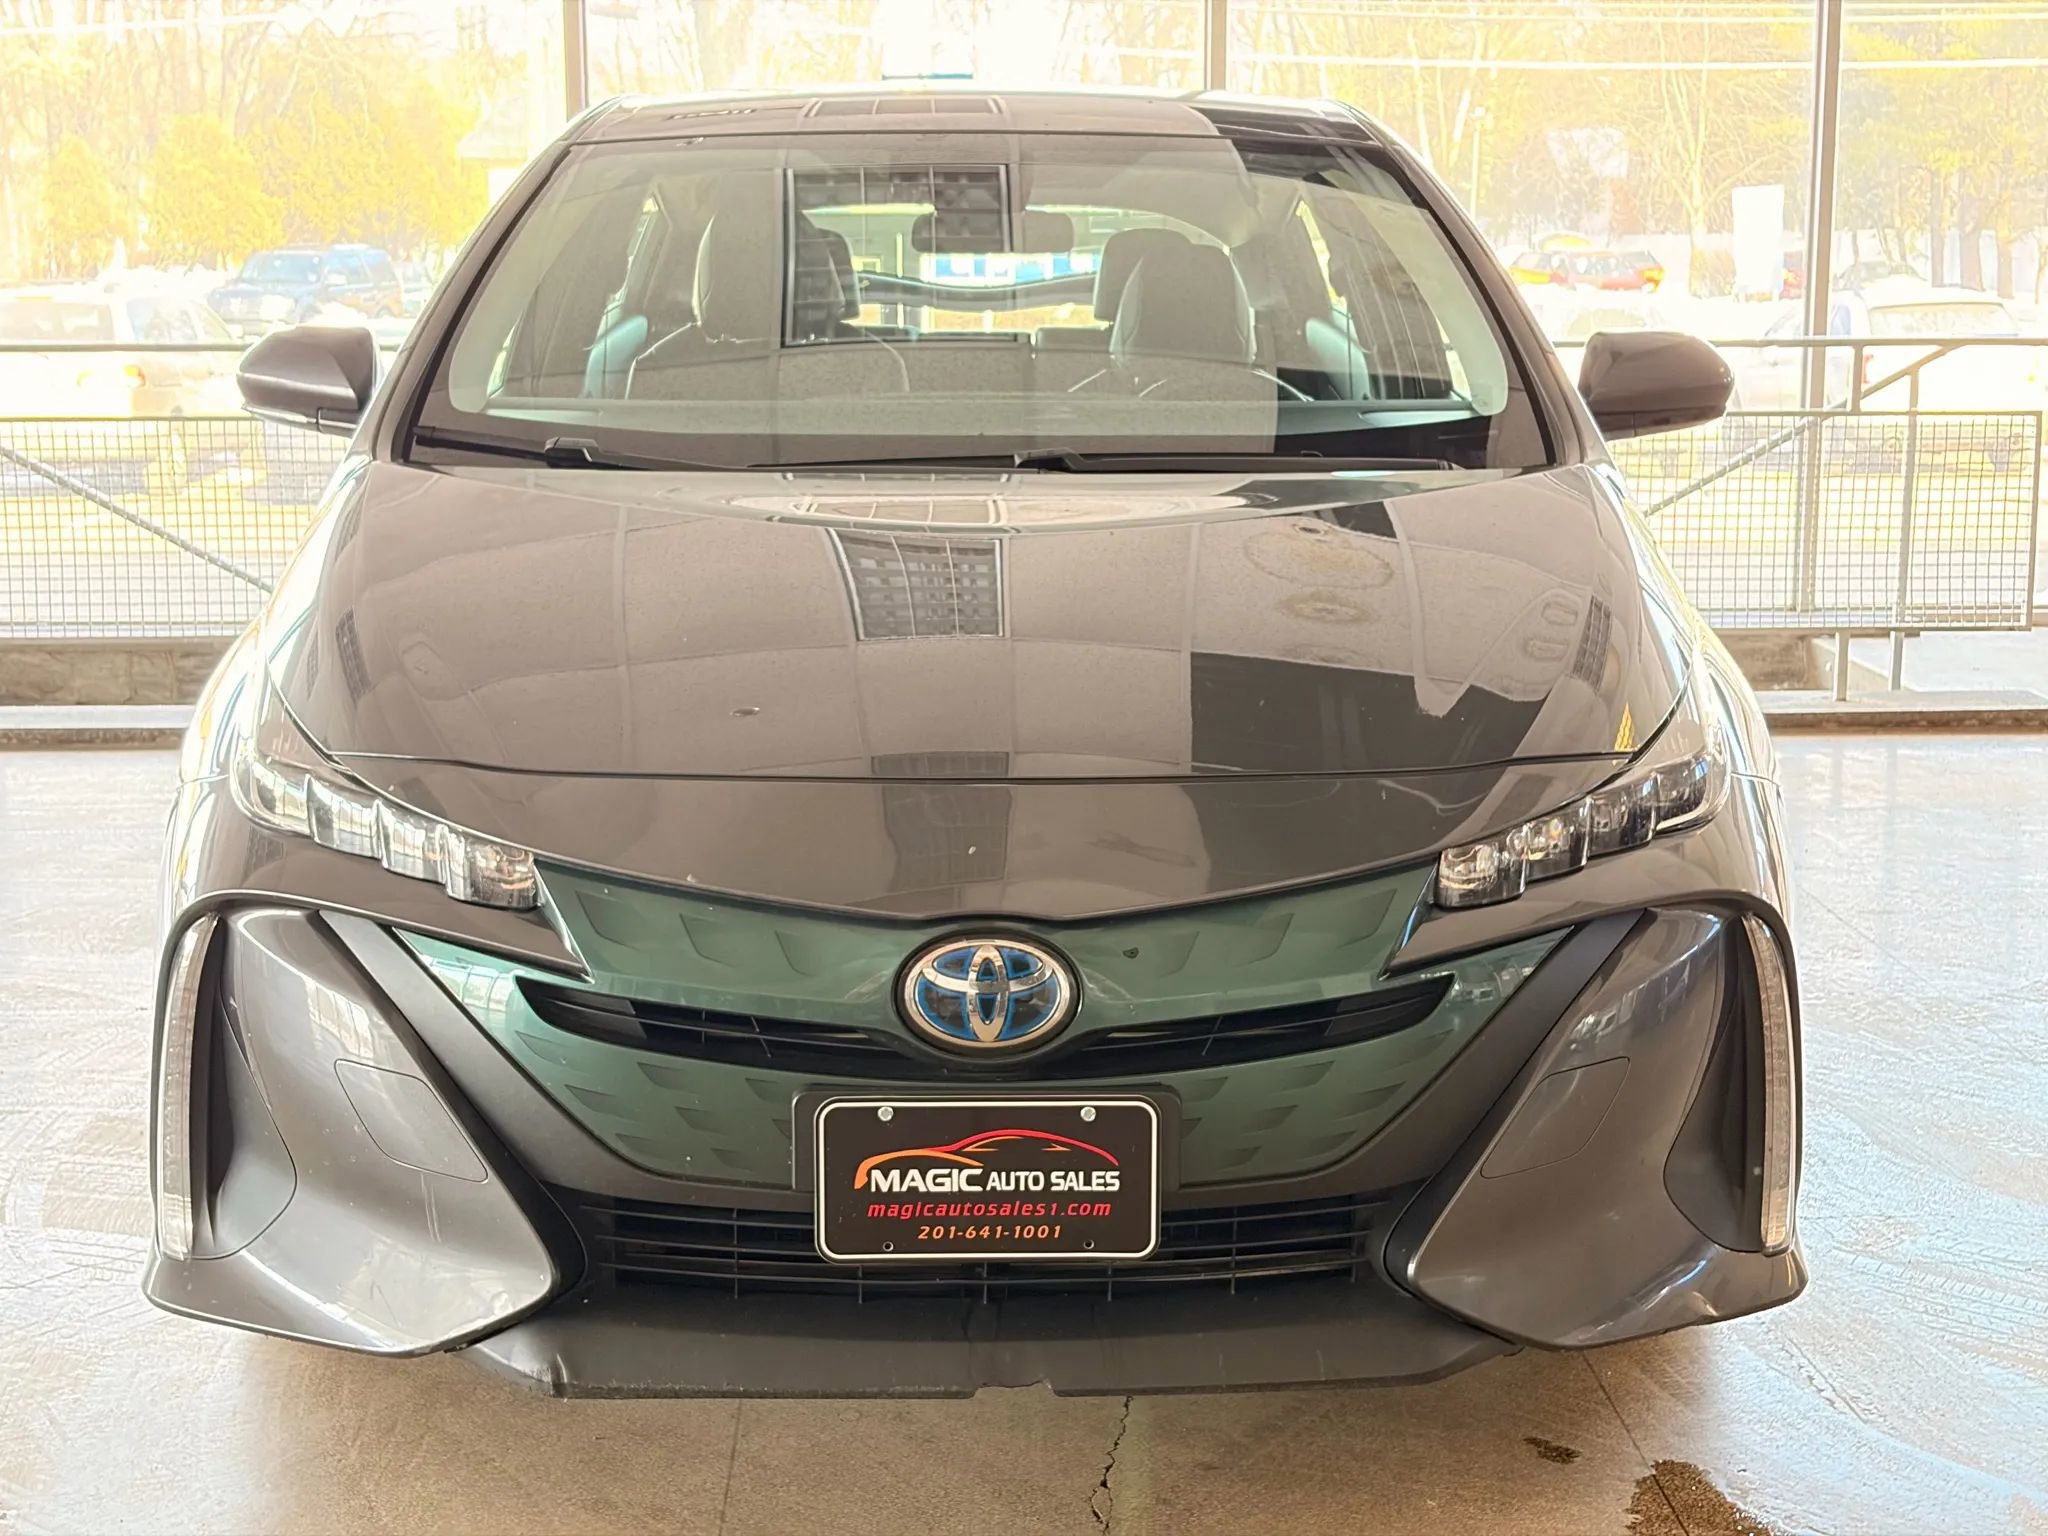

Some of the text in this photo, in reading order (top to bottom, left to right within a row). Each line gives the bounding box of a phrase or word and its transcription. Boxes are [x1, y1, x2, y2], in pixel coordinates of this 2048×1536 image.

[870, 1168, 1120, 1192] MAGIC AUTO SALES
[867, 1201, 1112, 1219] magicautosales1.com
[918, 1225, 1061, 1240] 201-641-1001
